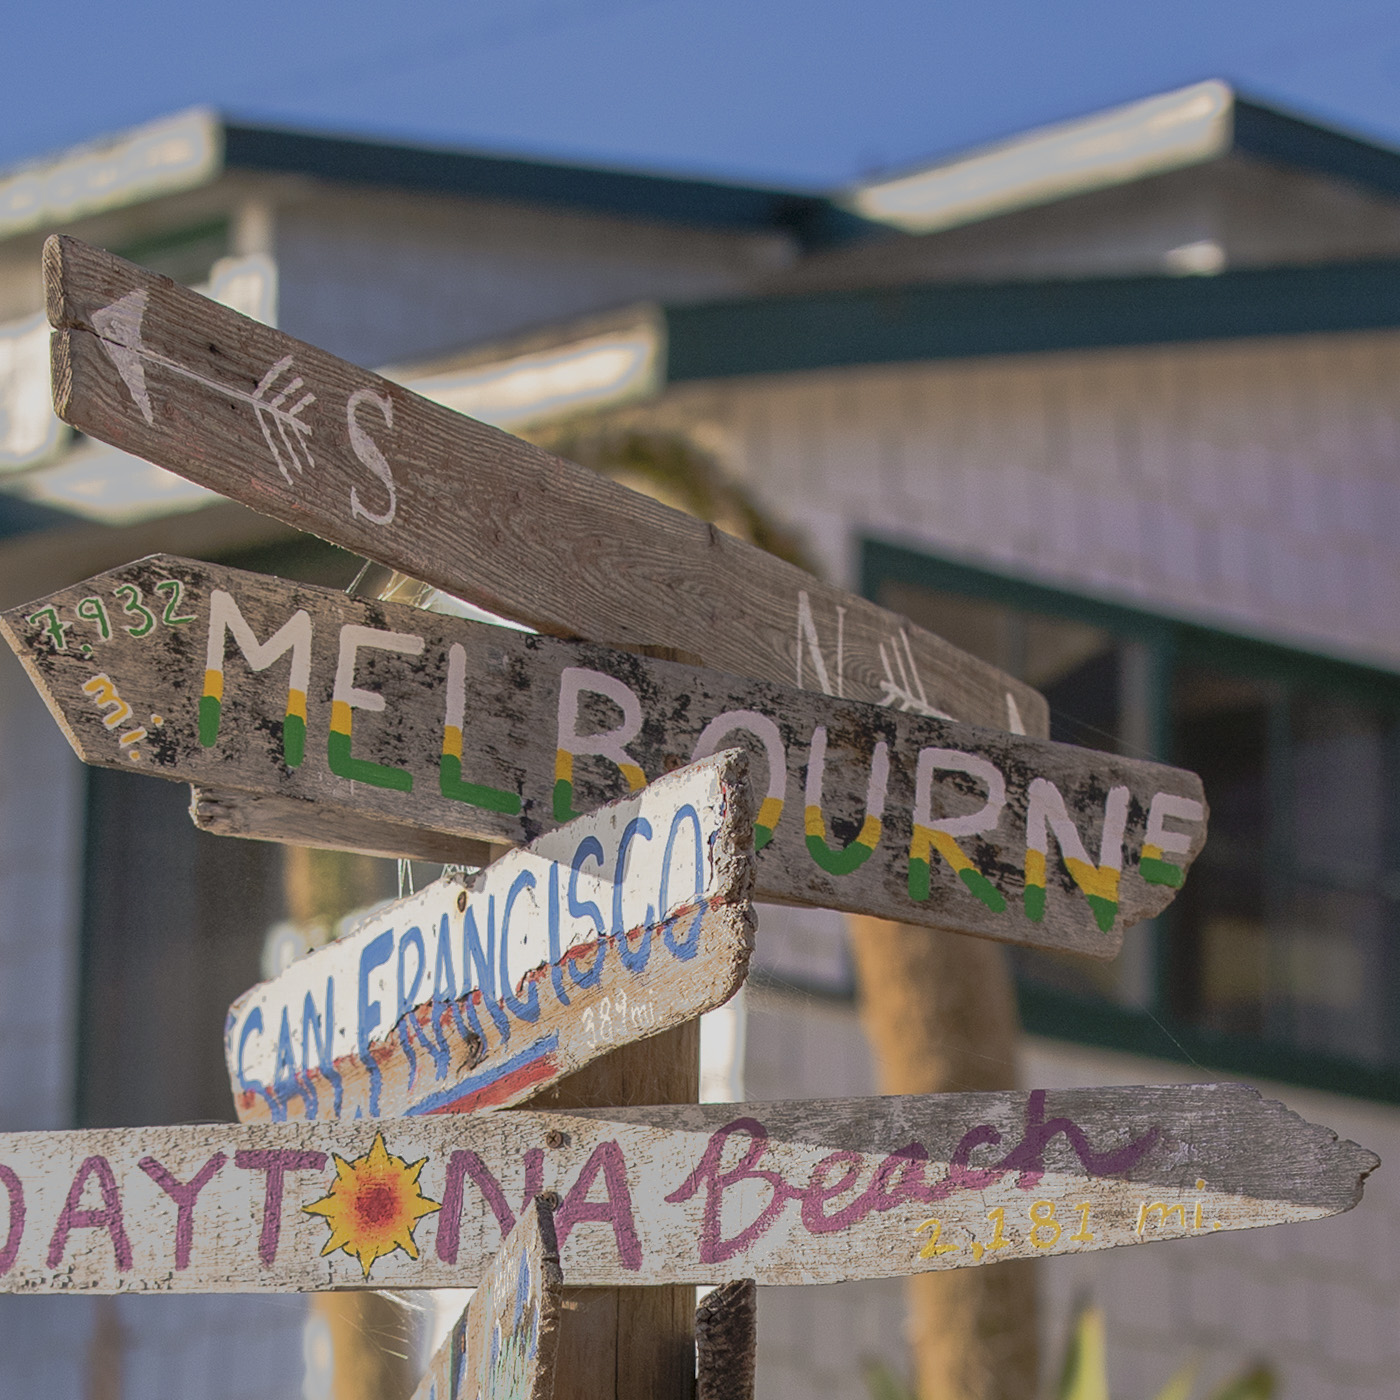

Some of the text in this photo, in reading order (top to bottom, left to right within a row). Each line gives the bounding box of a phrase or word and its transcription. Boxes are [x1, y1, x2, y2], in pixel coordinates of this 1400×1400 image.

[346, 388, 397, 525] S
[25, 578, 198, 660] 7,932
[358, 803, 708, 1119] FRANCISCO
[664, 1089, 1162, 1264] Beach
[915, 1199, 1095, 1262] 2,181
